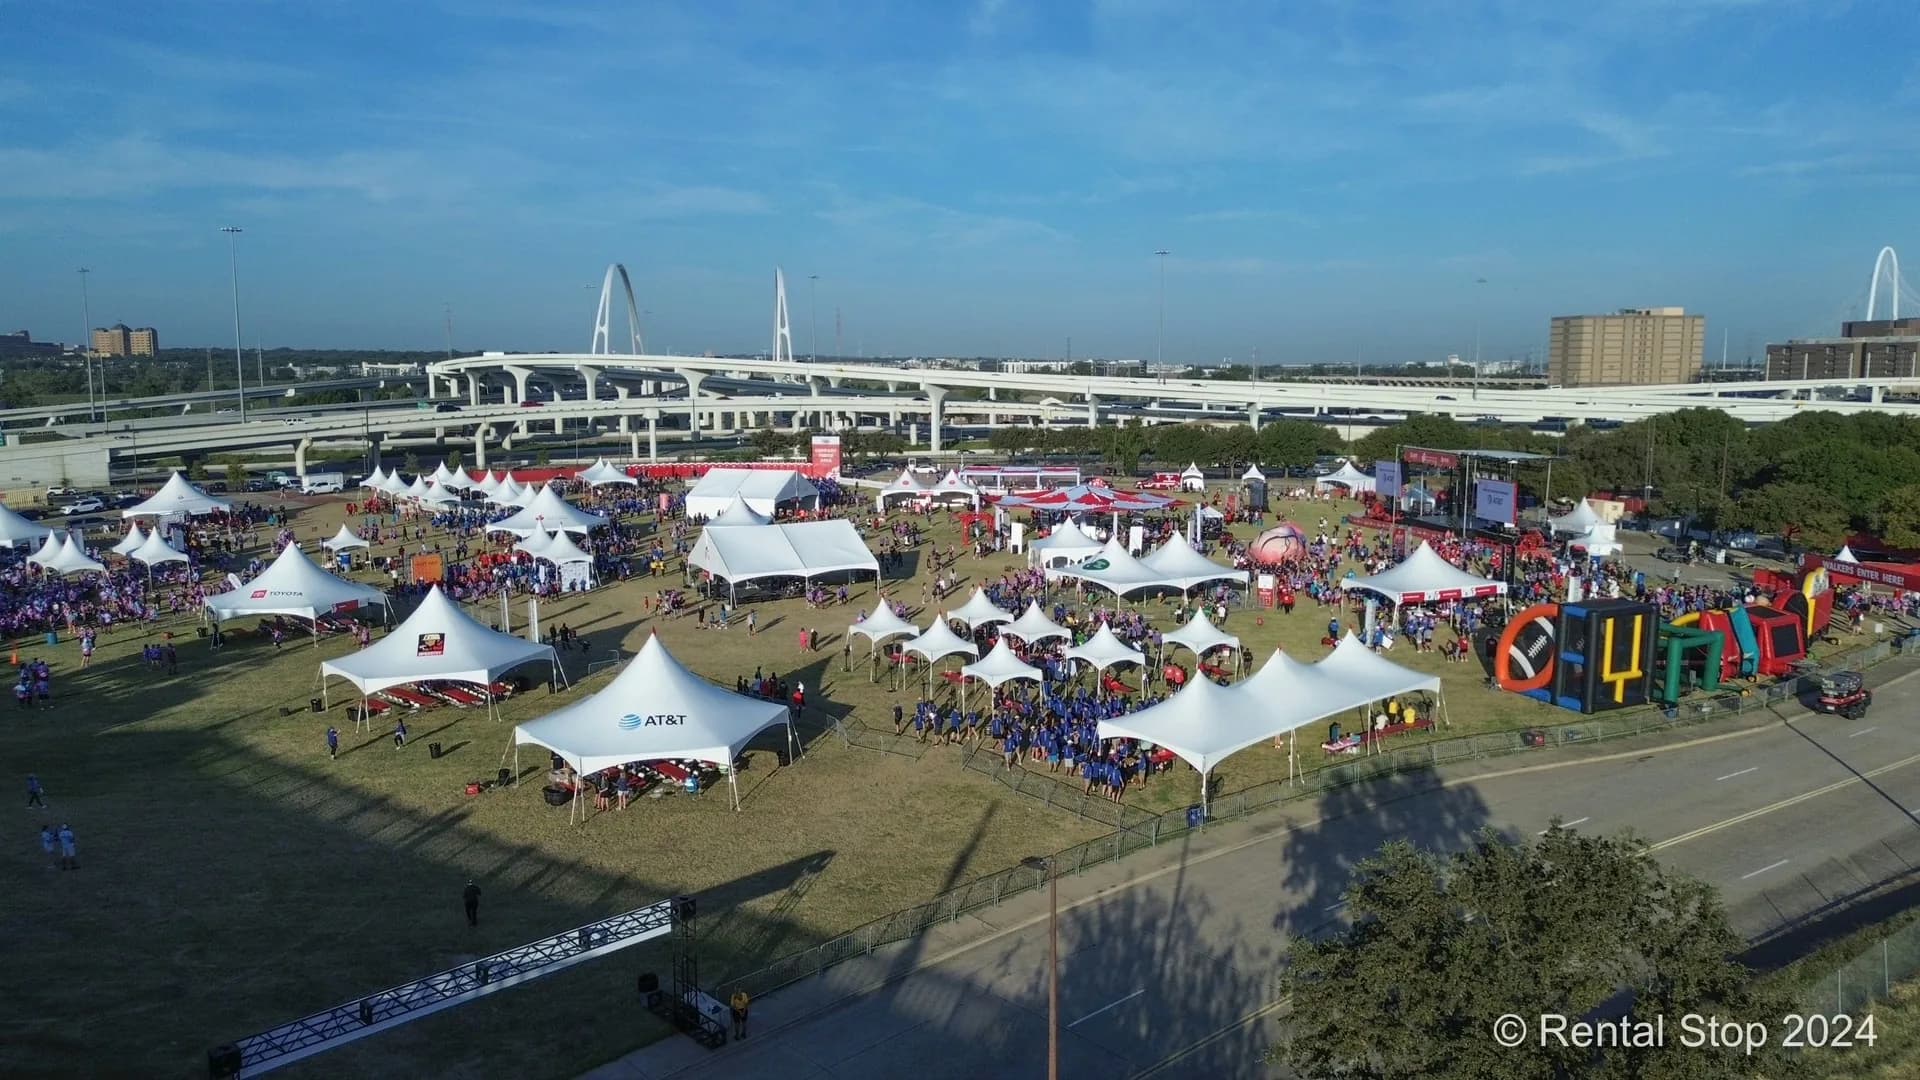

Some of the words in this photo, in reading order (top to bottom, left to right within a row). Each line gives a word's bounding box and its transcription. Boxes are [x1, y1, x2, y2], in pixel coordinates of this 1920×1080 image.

[1823, 560, 1854, 574] WALKERS
[1857, 568, 1879, 580] ENTER
[1882, 573, 1905, 585] HERE!
[645, 714, 687, 727] AT&T
